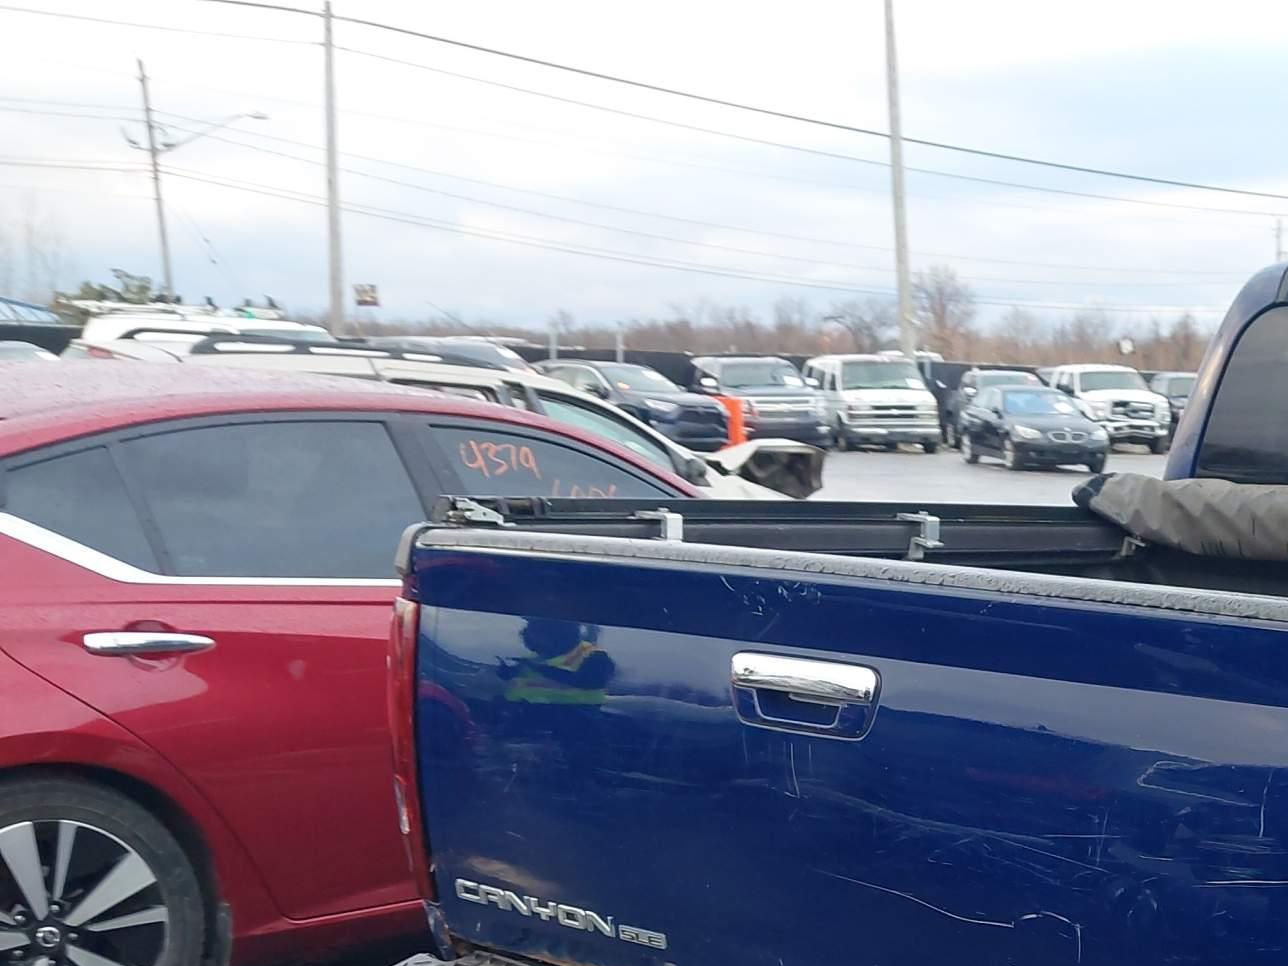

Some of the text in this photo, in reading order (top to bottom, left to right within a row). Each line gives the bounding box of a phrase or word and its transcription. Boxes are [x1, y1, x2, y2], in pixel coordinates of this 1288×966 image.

[459, 440, 542, 480] 4379
[455, 878, 668, 950] CANYON SLE
